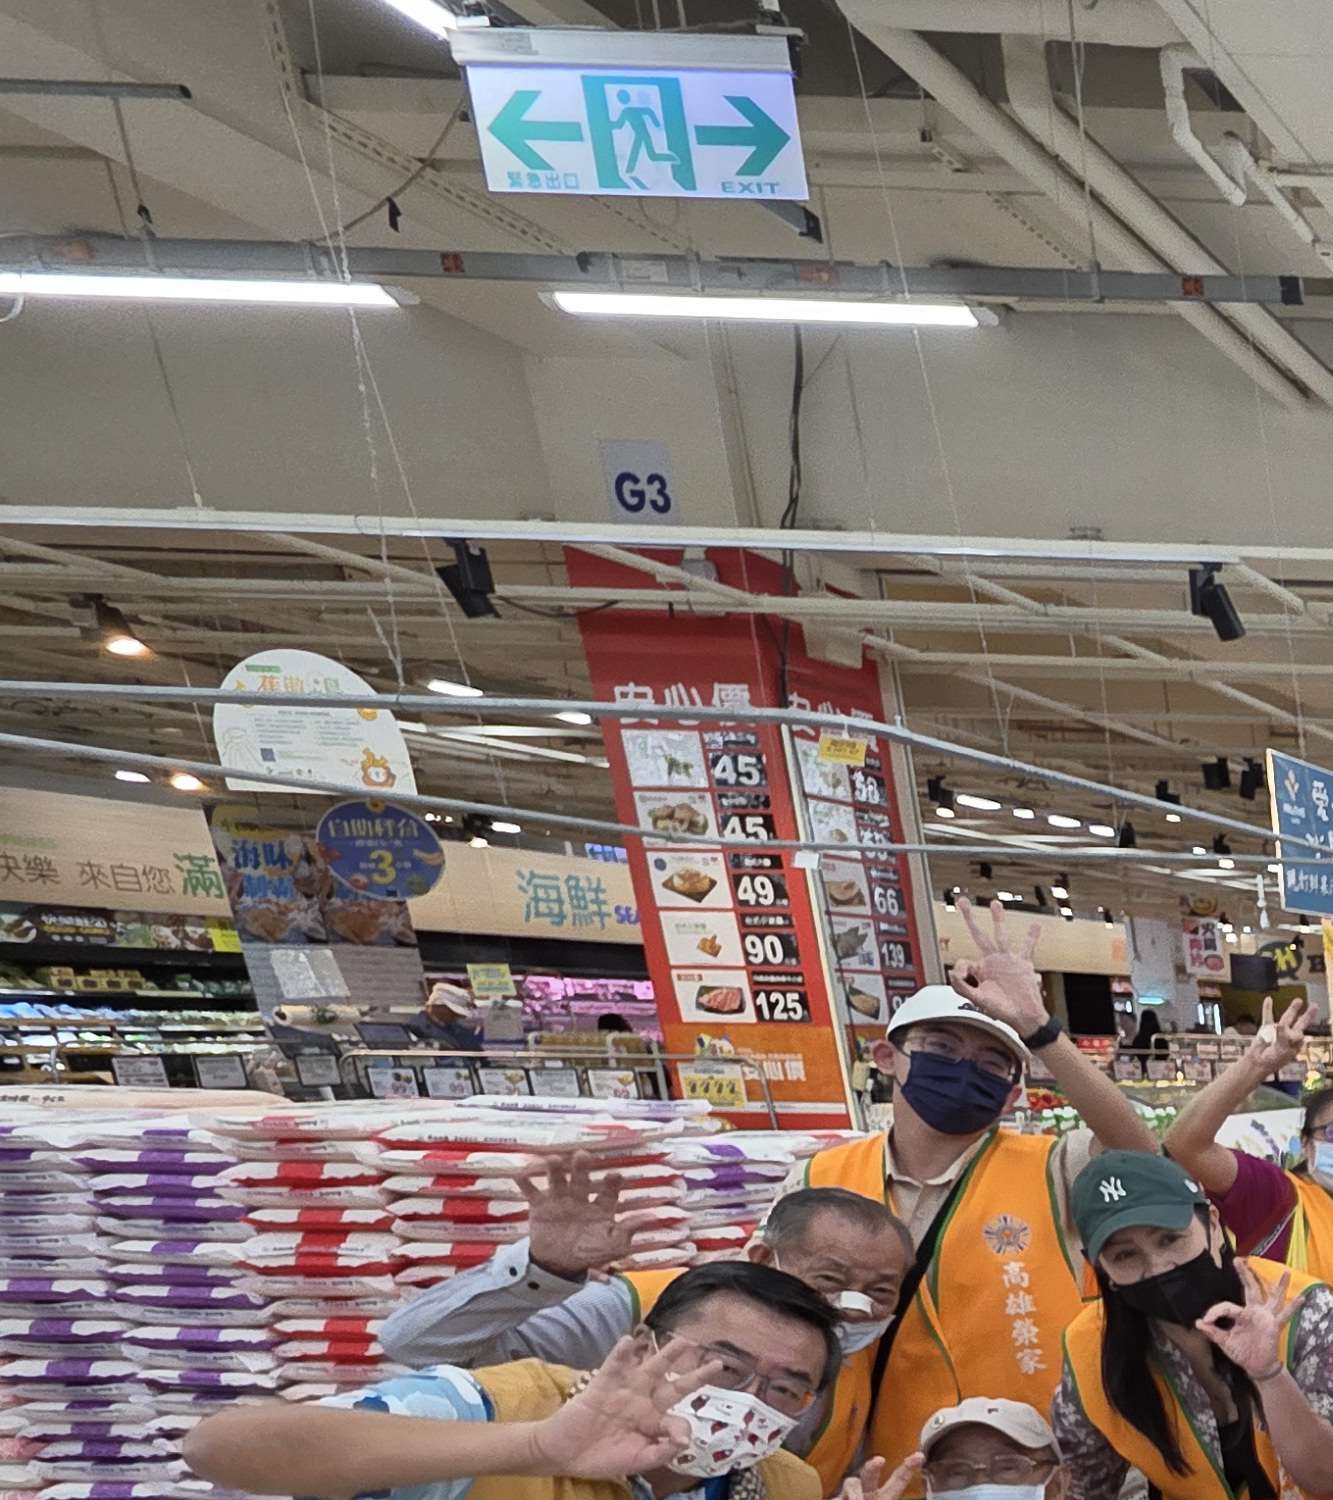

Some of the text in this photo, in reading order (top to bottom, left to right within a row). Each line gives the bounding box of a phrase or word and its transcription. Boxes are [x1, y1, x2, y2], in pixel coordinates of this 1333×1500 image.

[506, 170, 580, 190] 緊急出口
[720, 181, 780, 194] EXIT
[613, 471, 672, 516] G3
[713, 754, 761, 786] 45
[723, 815, 769, 841] 45
[369, 850, 397, 885] 3
[516, 870, 612, 930] 海鮮
[737, 875, 775, 906] 49
[874, 886, 899, 916] 66
[744, 934, 784, 965] 90
[755, 991, 803, 1021] 125
[1002, 1260, 1047, 1375] 高雄榮家
